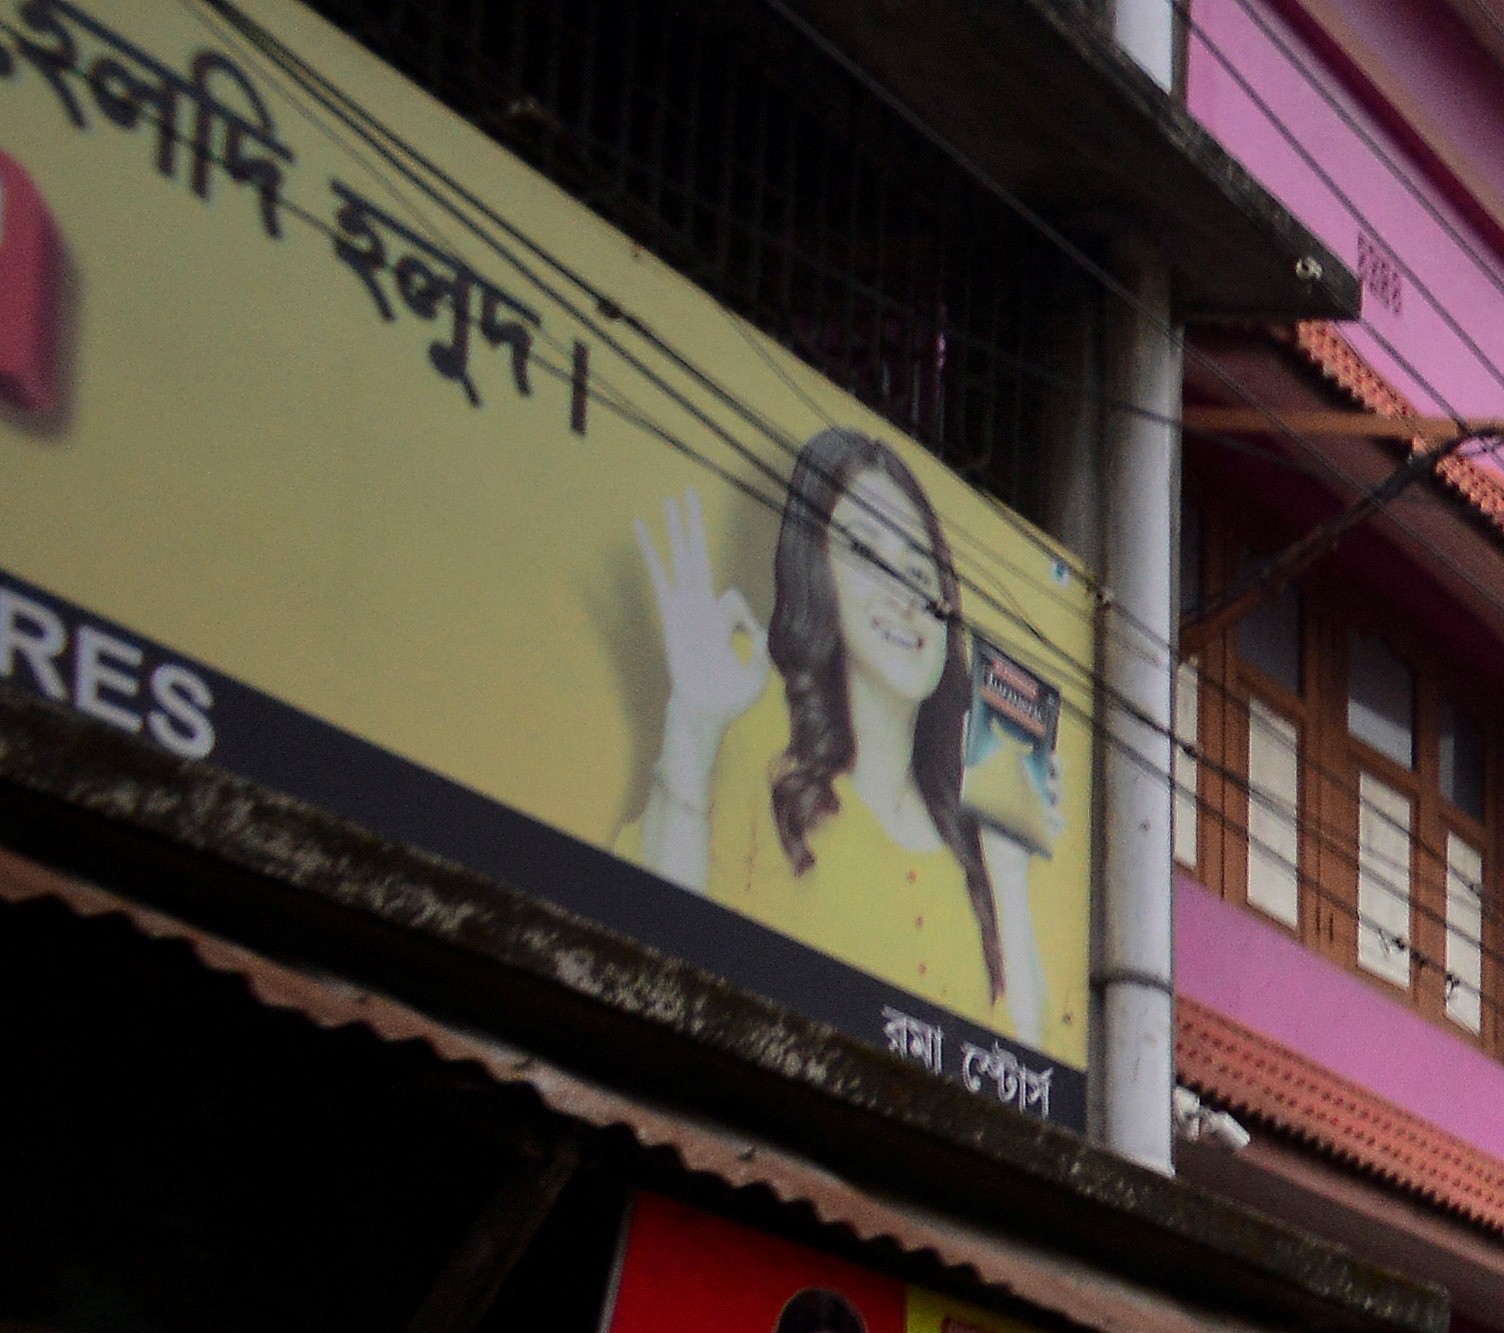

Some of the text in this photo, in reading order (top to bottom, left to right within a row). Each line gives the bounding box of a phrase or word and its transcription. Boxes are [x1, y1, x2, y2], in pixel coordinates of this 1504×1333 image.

[0, 0, 294, 238] হলদি
[0, 587, 216, 761] RES
[880, 1004, 944, 1076] রমা
